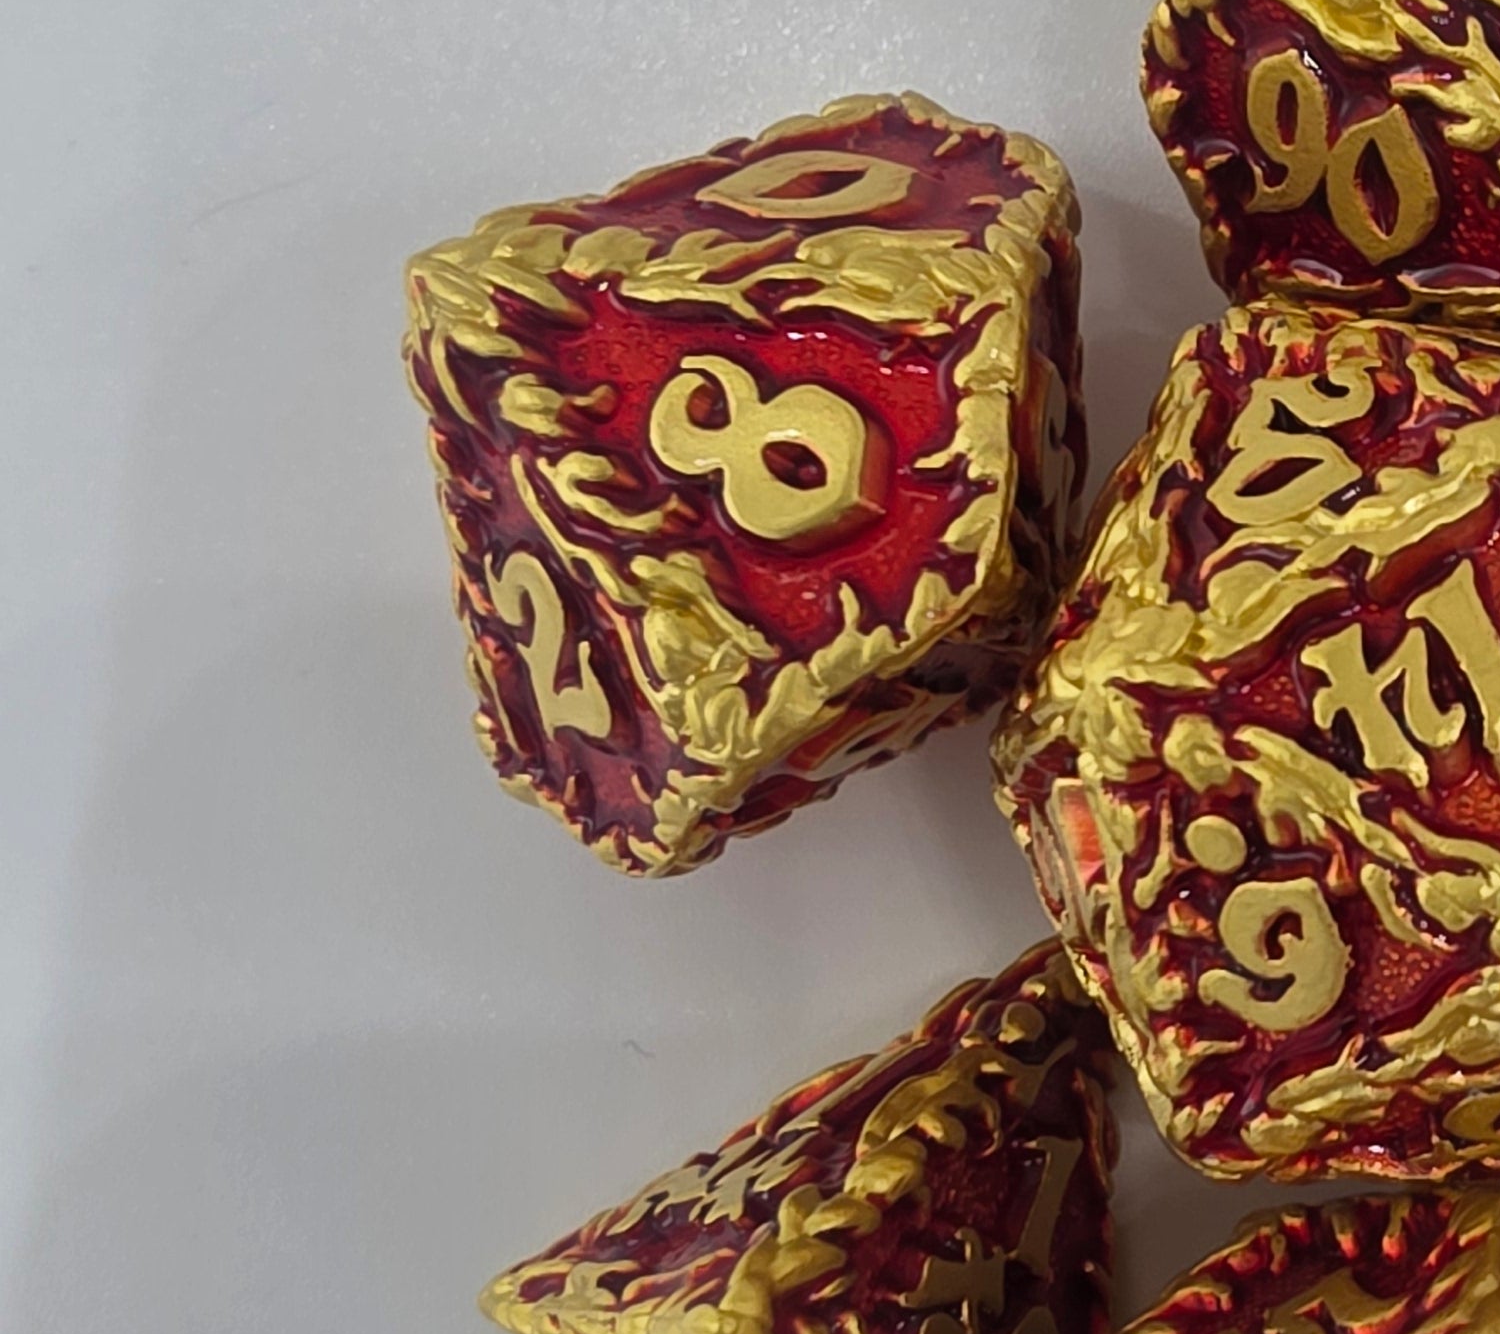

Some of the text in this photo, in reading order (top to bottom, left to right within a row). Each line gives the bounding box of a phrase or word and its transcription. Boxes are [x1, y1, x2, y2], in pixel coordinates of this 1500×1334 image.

[695, 149, 923, 220] 0
[1246, 50, 1440, 266] 90
[650, 353, 870, 539] 8
[1206, 365, 1378, 525] 20
[485, 552, 613, 739] 2
